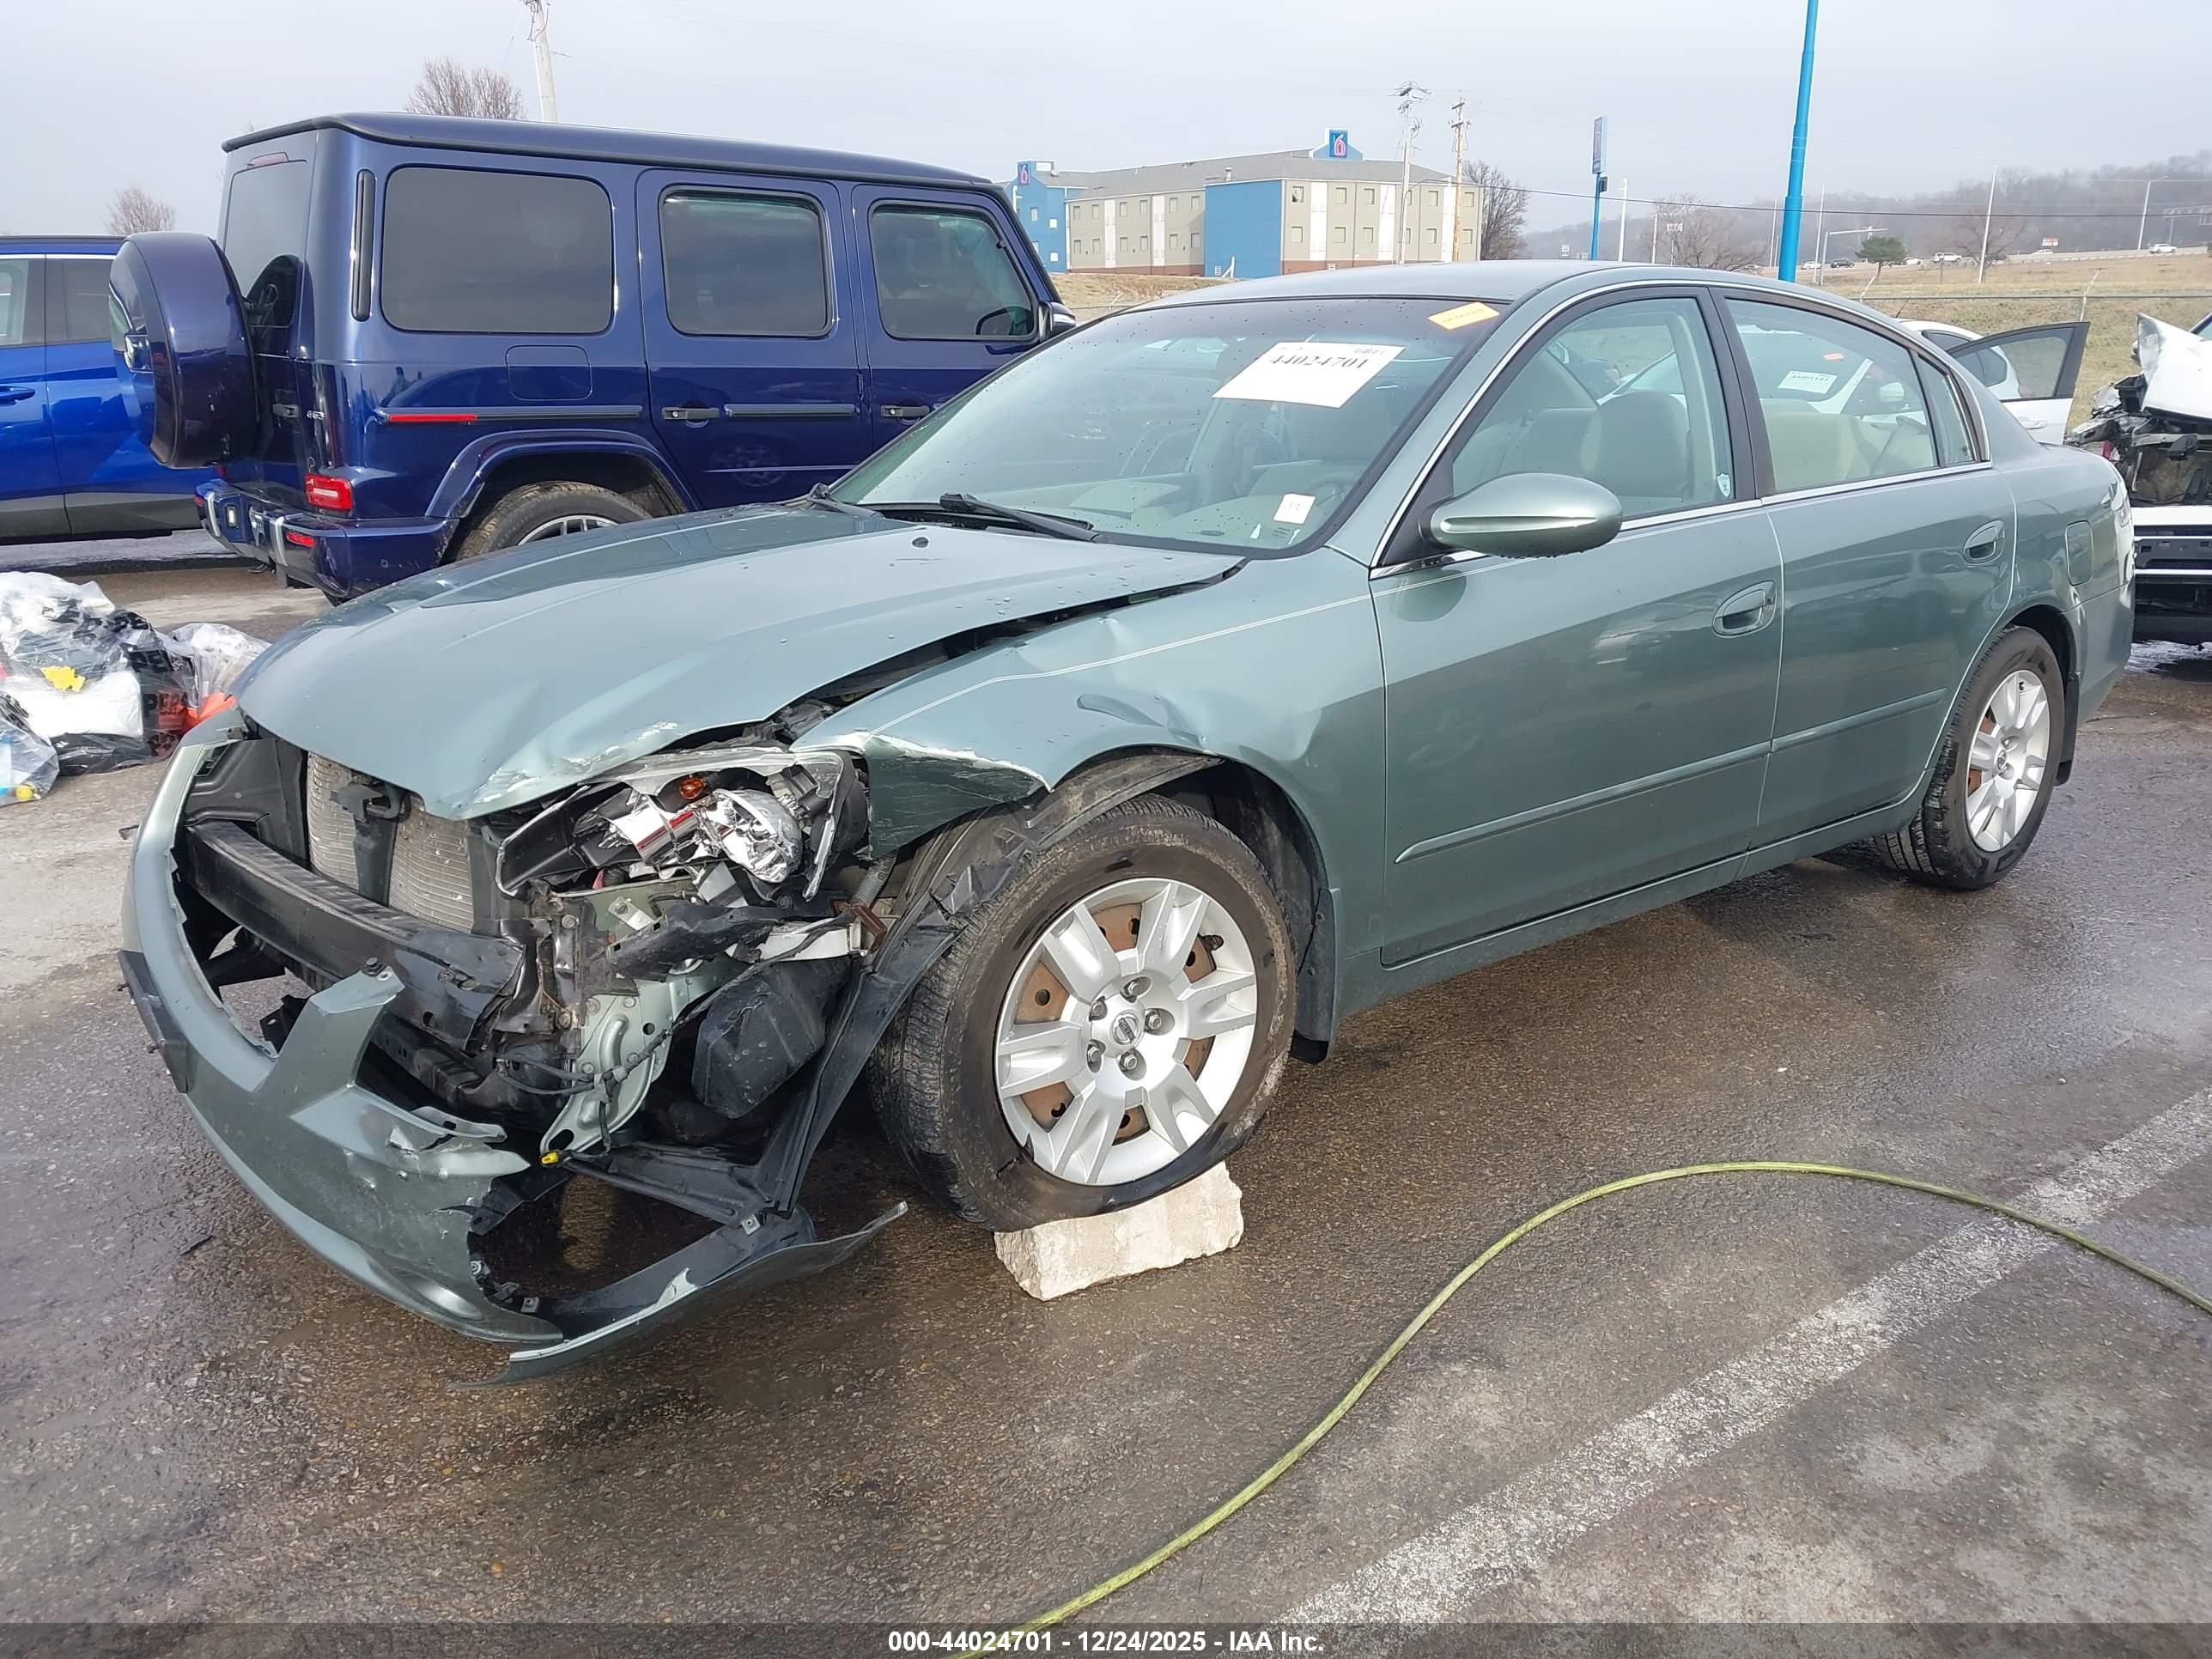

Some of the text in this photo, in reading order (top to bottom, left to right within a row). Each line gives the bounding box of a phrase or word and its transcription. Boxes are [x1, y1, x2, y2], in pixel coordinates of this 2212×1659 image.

[1334, 133, 1346, 156] 6
[1018, 164, 1028, 185] 6
[1269, 354, 1370, 369] 44024701
